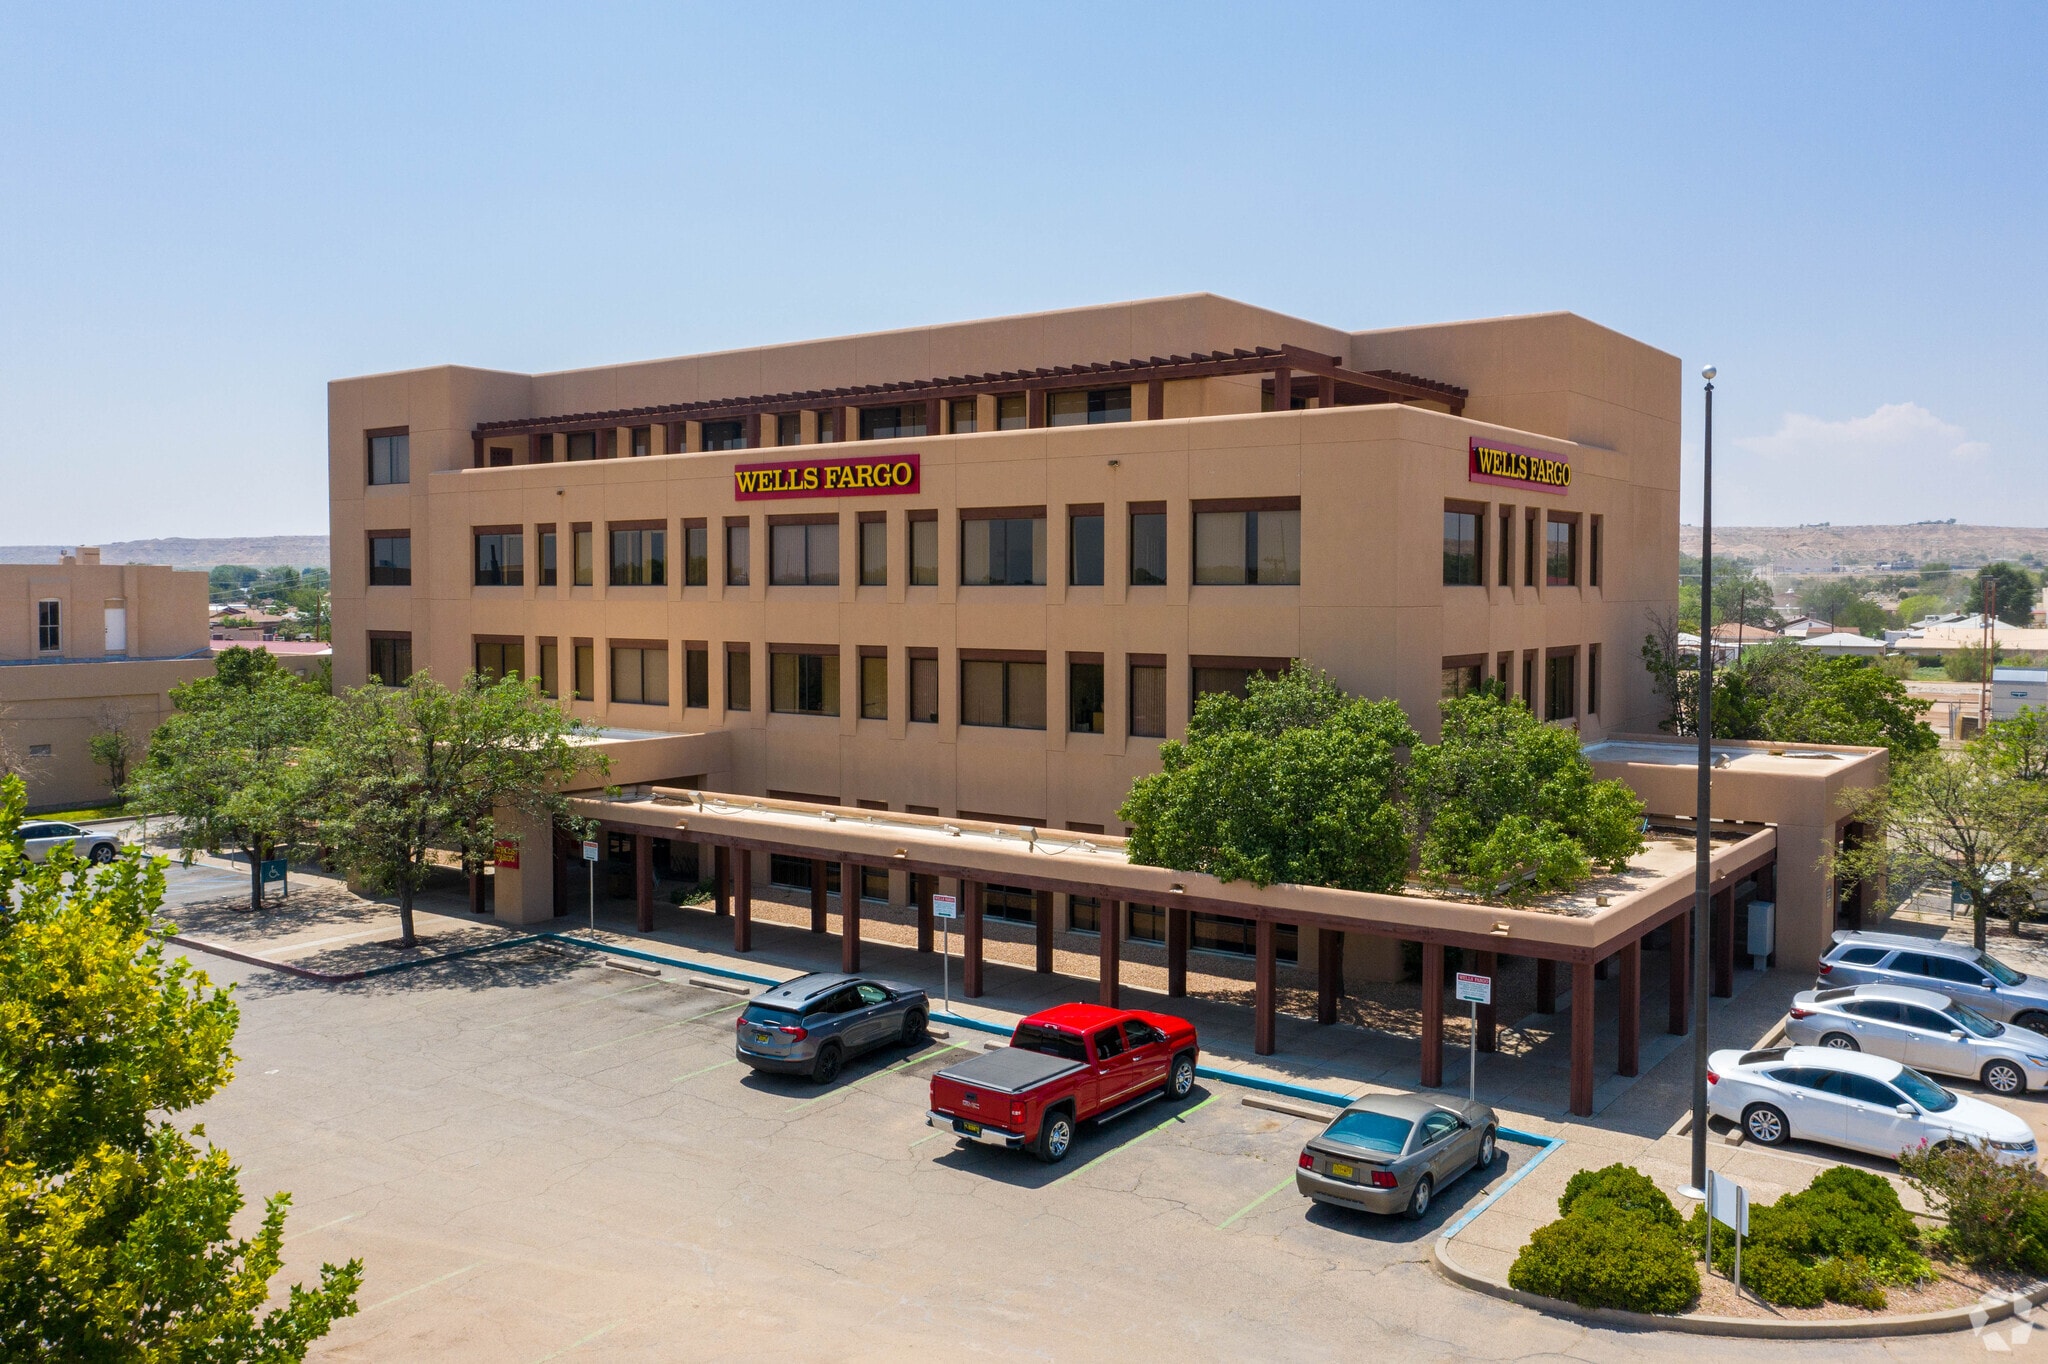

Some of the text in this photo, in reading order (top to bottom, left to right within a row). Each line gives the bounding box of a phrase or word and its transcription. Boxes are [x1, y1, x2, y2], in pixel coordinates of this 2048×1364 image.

[735, 462, 912, 493] WELLS FARGO
[1478, 447, 1571, 486] WELLS FARGO
